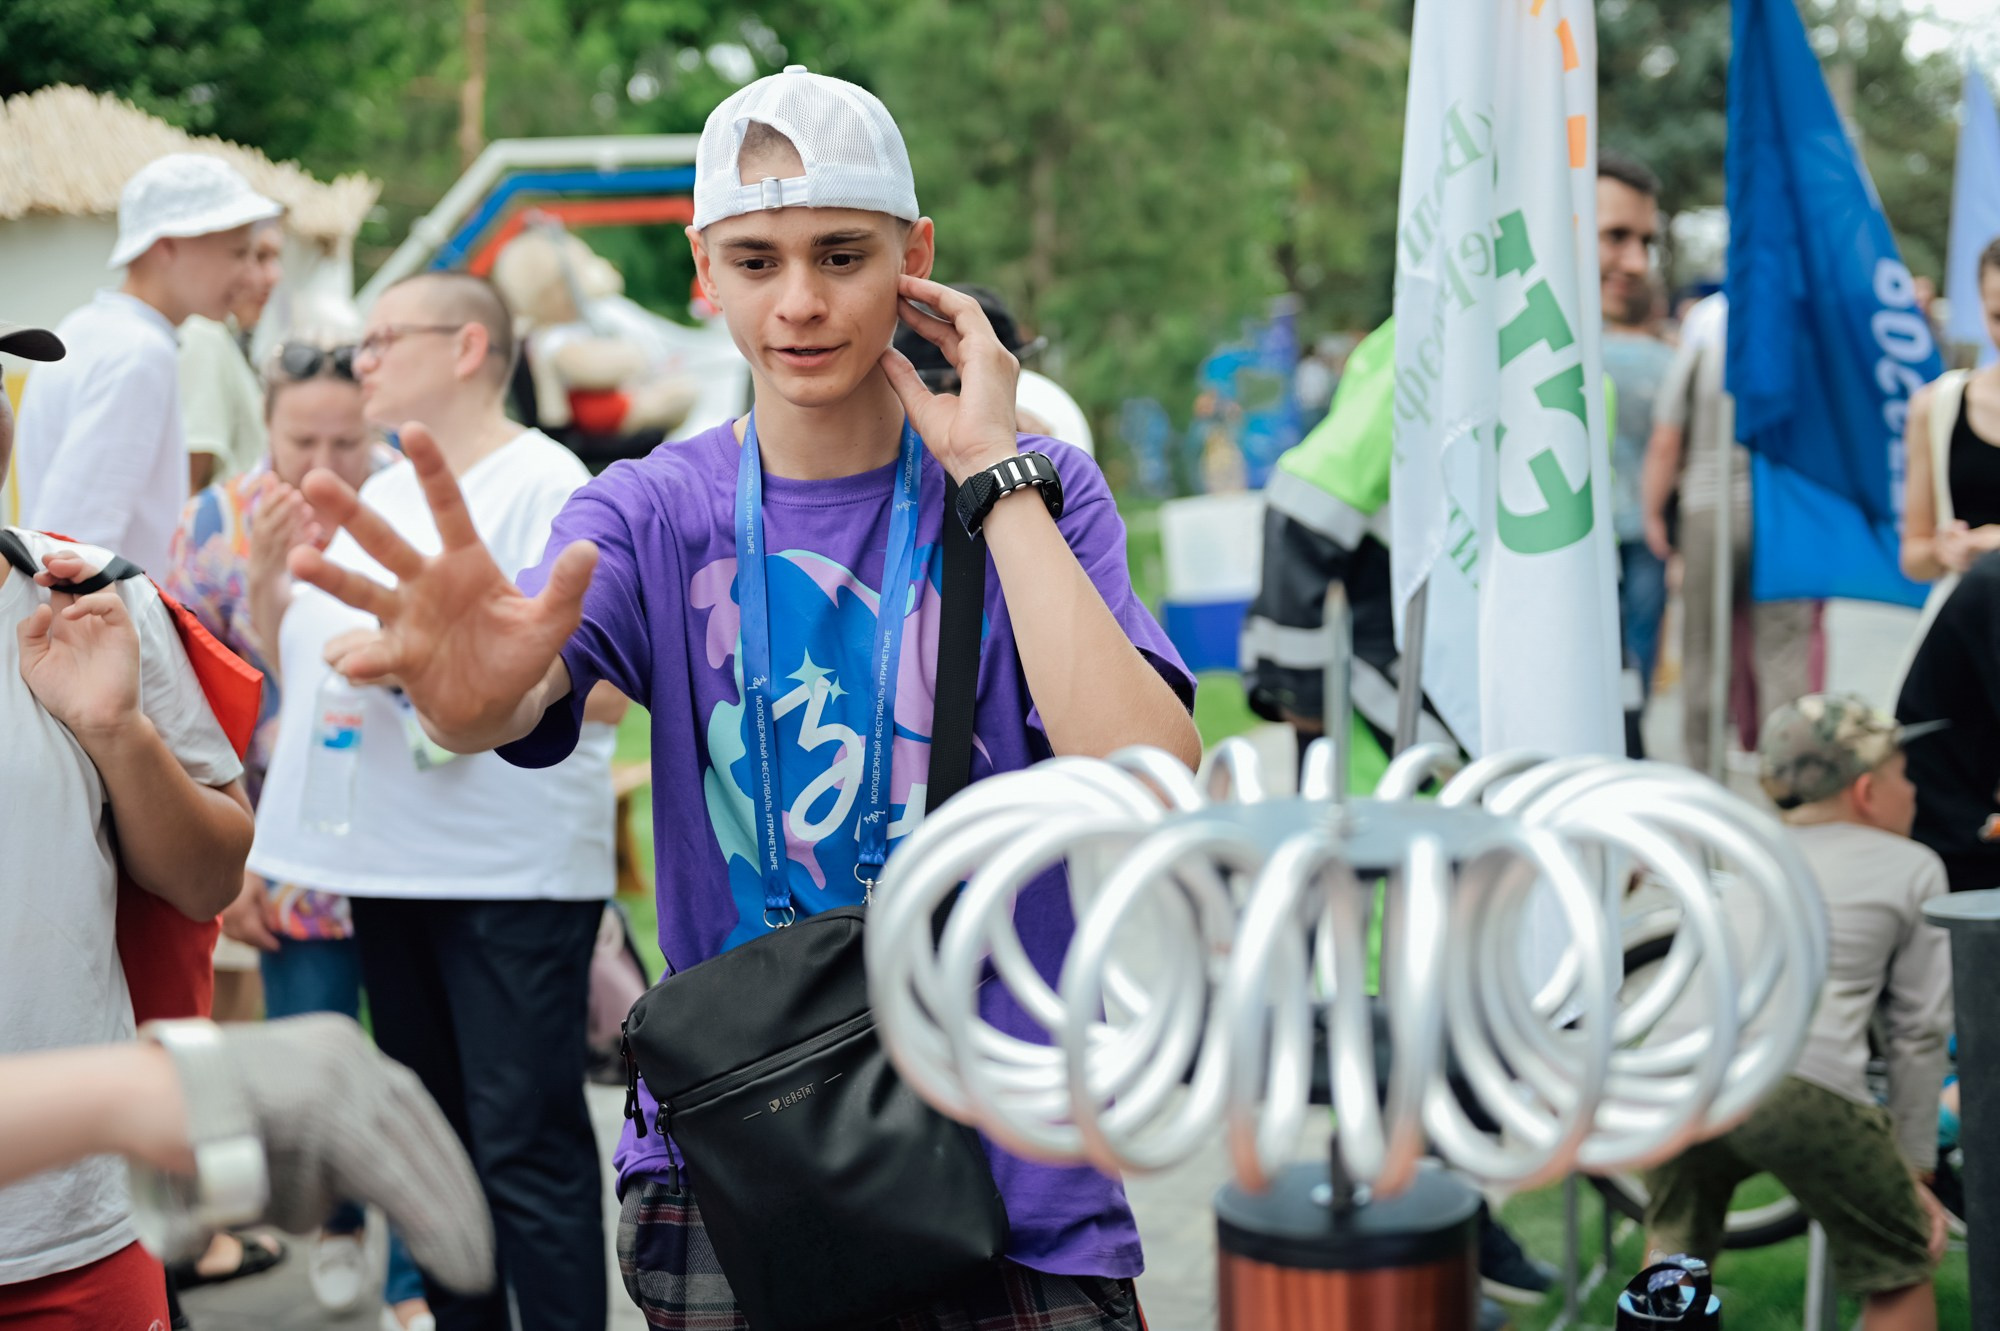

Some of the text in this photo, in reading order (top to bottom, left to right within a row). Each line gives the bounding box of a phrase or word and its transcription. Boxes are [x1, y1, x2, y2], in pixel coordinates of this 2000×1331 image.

[755, 695, 779, 871] МОЛОДЕЖНЫЙ ФЕСТИВАЛЬ #ТРИЧЕТЫРЕ
[871, 629, 893, 804] МОЛОДЕЖНЫЙ ФЕСТИВАЛЬ #ТРИЧЕТЫРЕ
